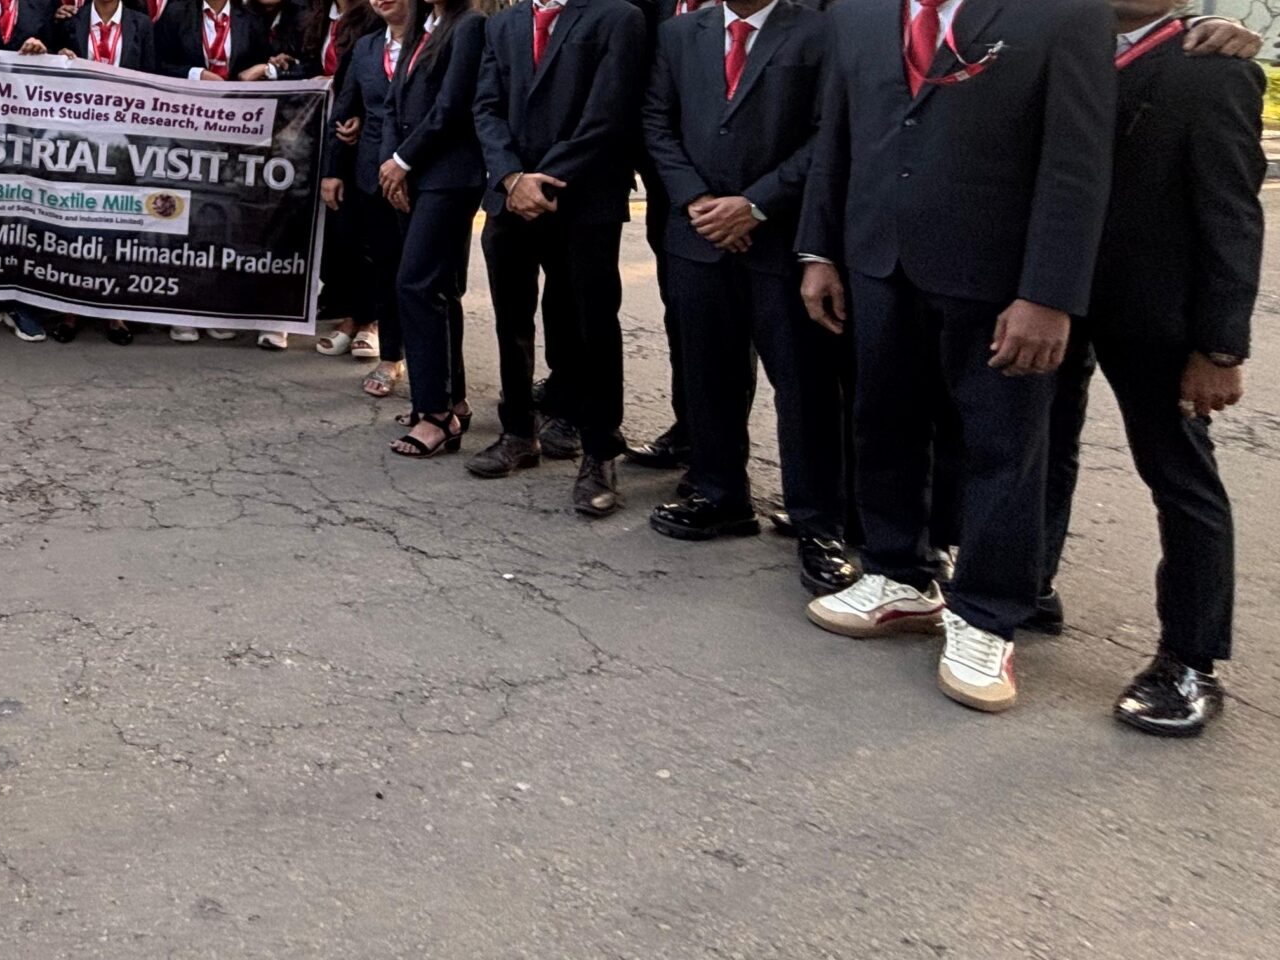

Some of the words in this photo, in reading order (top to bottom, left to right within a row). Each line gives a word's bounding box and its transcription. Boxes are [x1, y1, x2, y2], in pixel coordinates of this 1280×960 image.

[25, 85, 146, 112] Visvesvaraya
[151, 97, 236, 119] Institute
[242, 107, 264, 122] of
[59, 107, 109, 122] Studies
[114, 112, 126, 123] &
[131, 112, 198, 131] Research,
[204, 121, 264, 135] Mumbai
[127, 143, 229, 182] VISIT
[238, 154, 295, 190] TO
[38, 188, 97, 209] Textile
[102, 194, 143, 212] Mills
[115, 239, 214, 269] Himachal
[221, 247, 305, 275] Pradesh
[23, 259, 120, 295] February,
[127, 275, 180, 296] 2025
